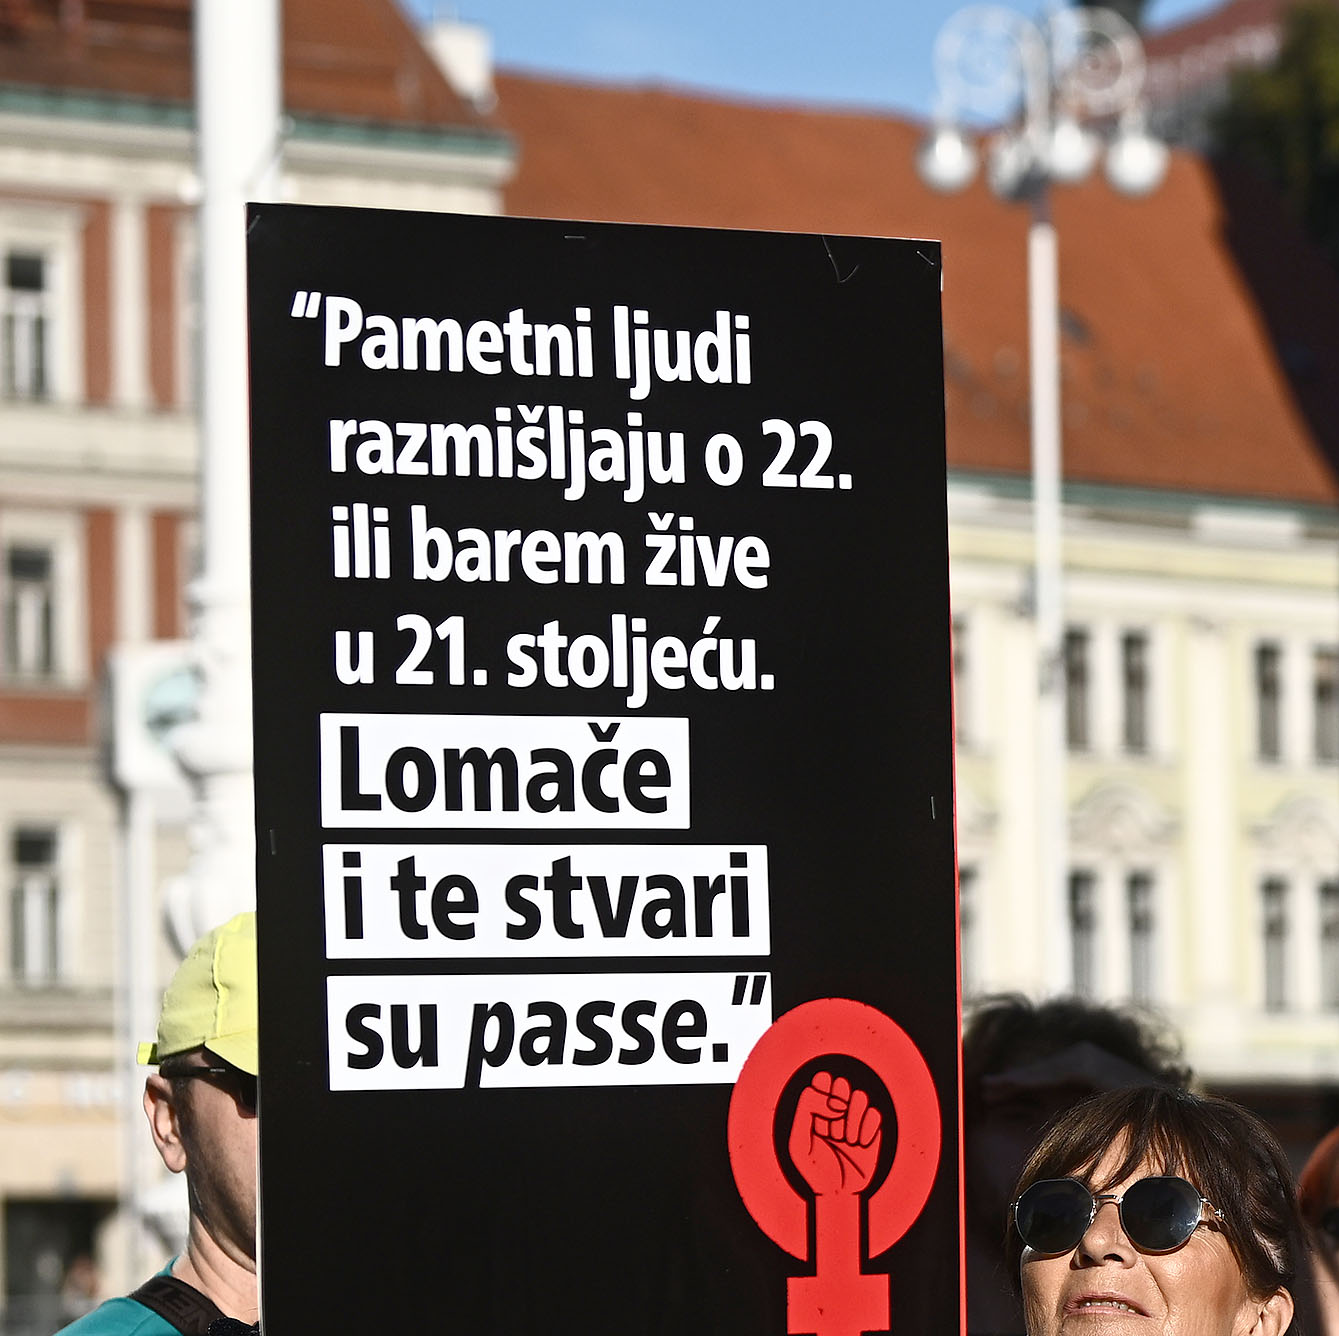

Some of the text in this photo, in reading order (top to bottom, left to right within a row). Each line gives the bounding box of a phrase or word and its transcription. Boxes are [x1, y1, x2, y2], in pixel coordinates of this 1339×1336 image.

[291, 290, 751, 401] “Pametni ljudi
[329, 404, 853, 503] razmišljaju o 22.
[332, 504, 771, 590] ili barem žive
[335, 613, 775, 707] u 21. stoljeću.
[339, 721, 672, 814] Lomače
[342, 851, 750, 941] i te stvari
[345, 974, 768, 1088] su passe.”
